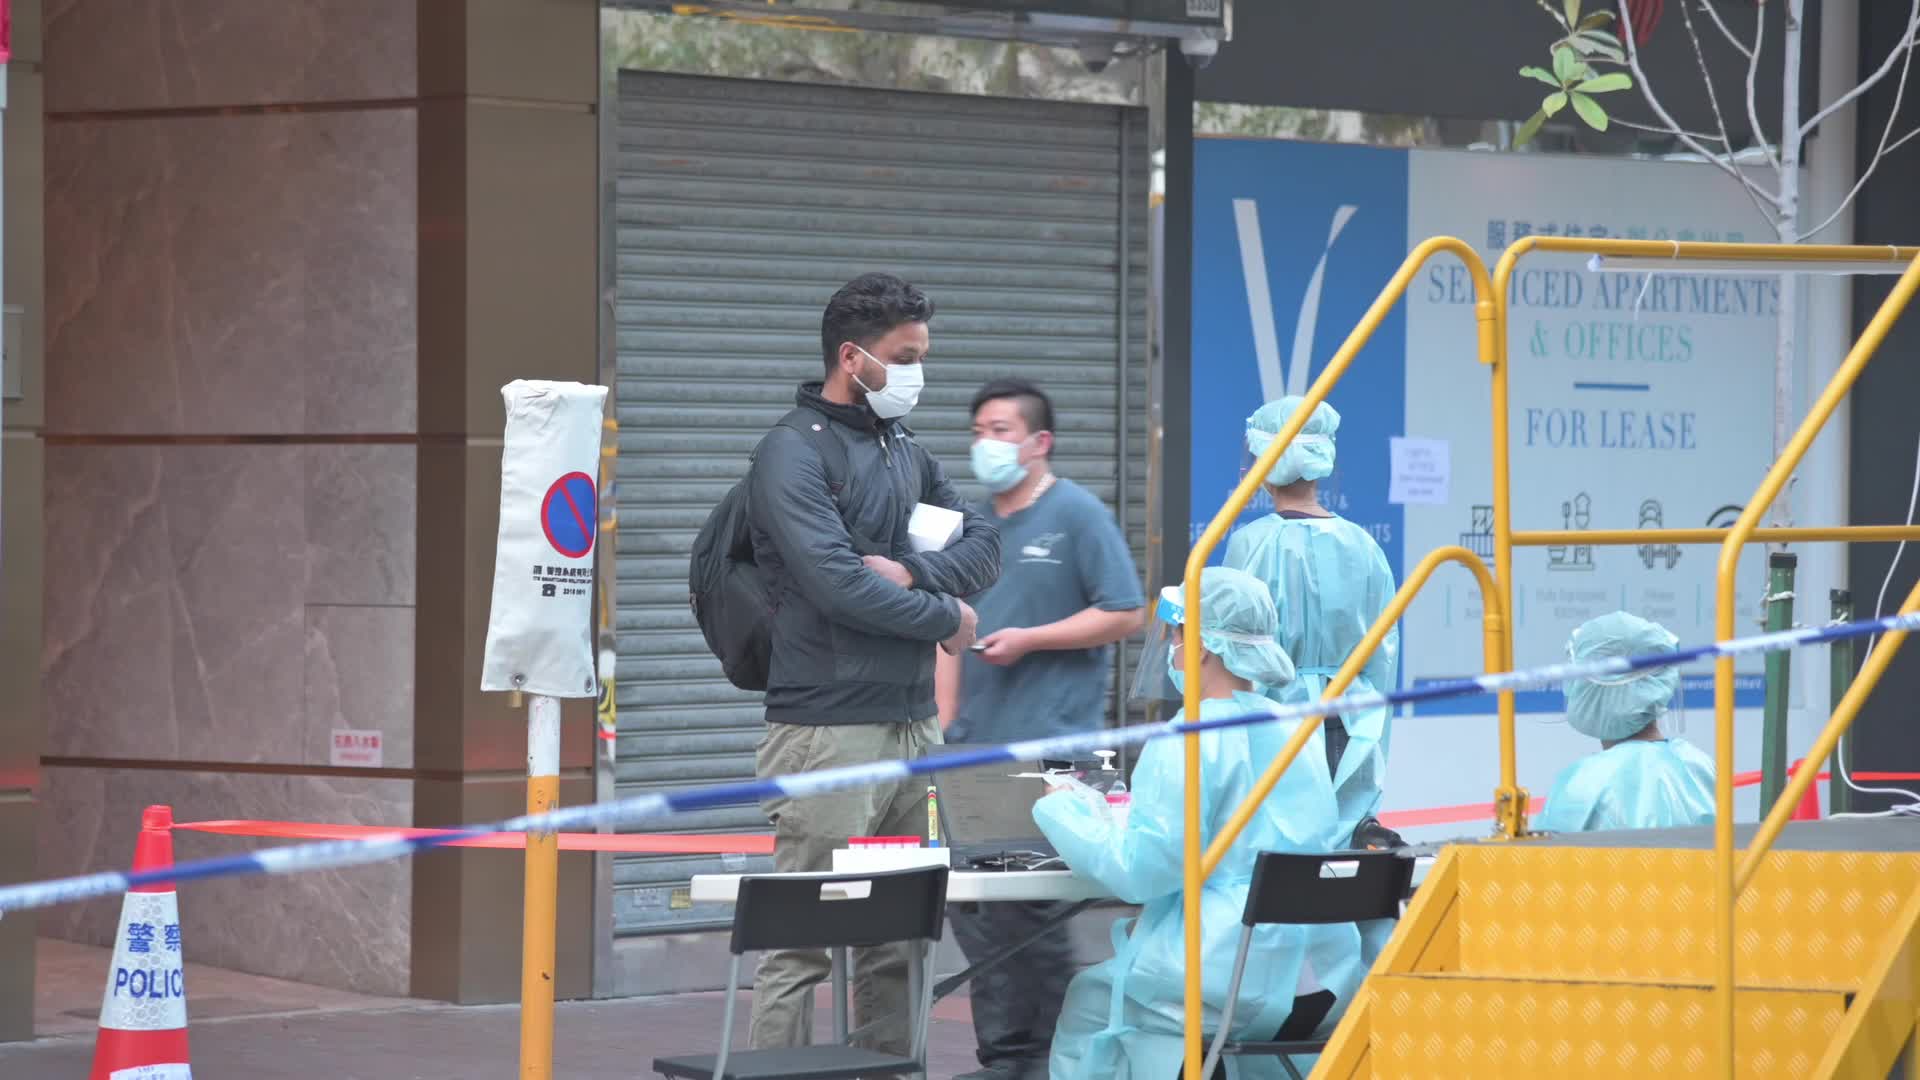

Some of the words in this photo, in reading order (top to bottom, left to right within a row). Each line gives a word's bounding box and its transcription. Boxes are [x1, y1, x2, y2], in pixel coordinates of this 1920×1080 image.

[1428, 264, 1583, 310] SEICED
[1529, 319, 1549, 357] &
[1564, 320, 1694, 363] OFFICES
[1525, 407, 1590, 449] FOR
[1599, 409, 1697, 451] LEASE
[114, 967, 184, 998] POLIC
